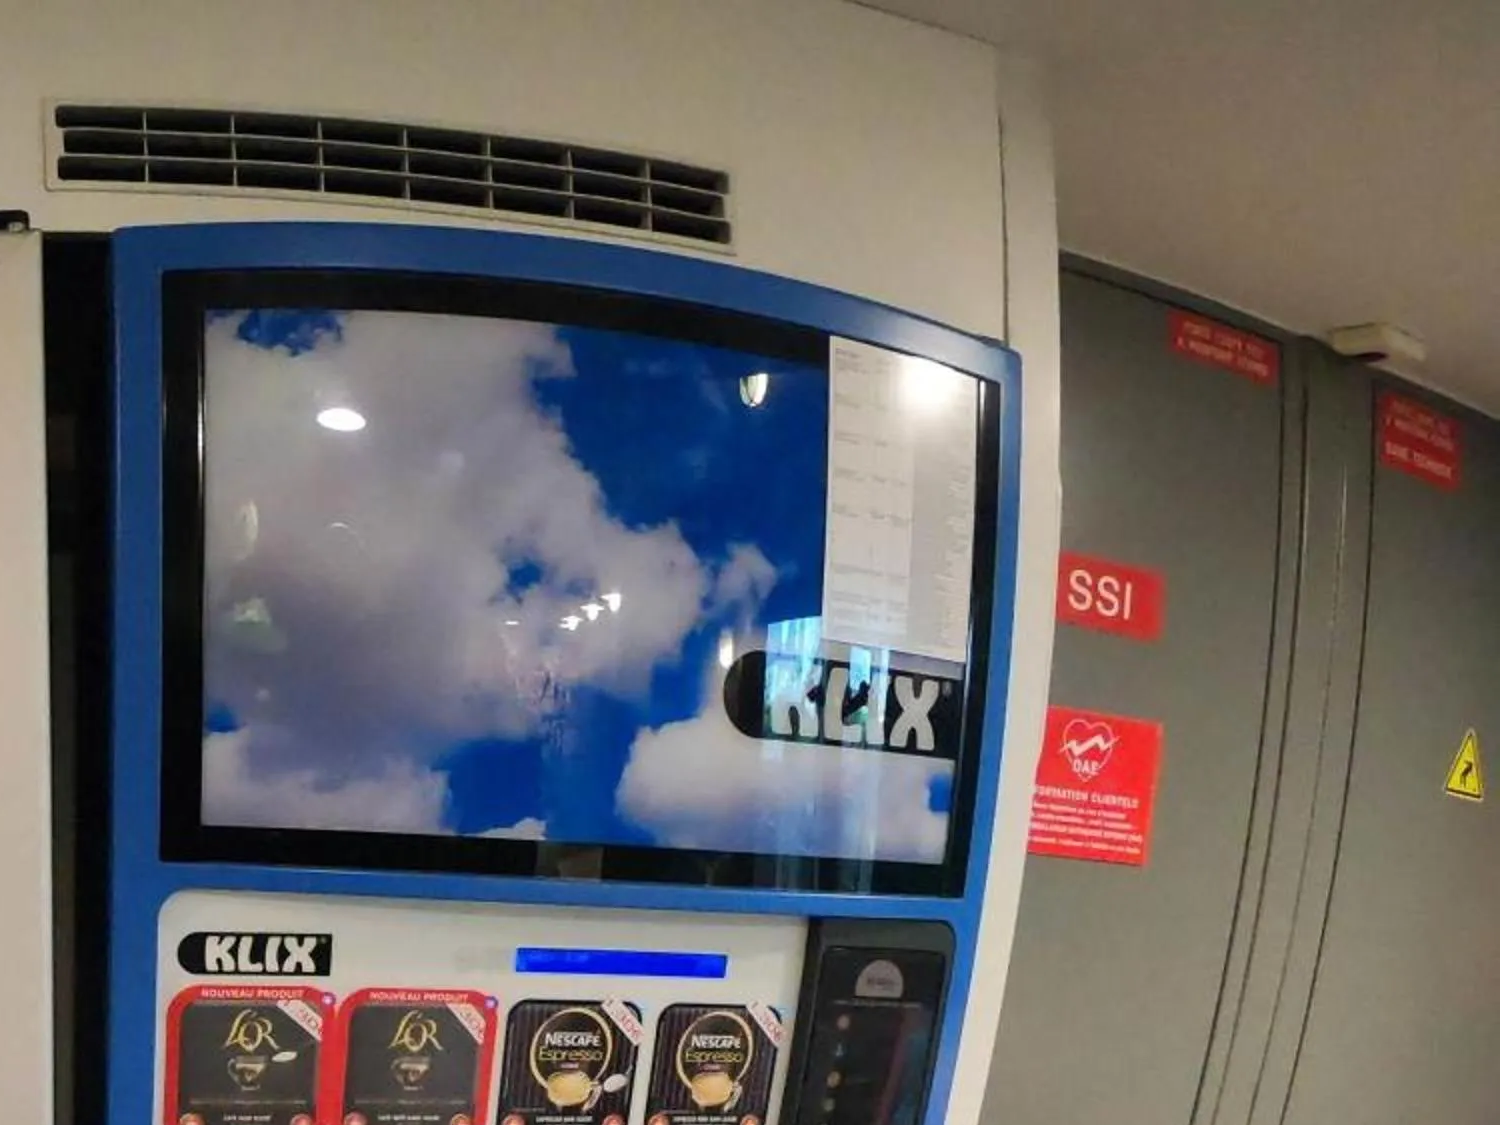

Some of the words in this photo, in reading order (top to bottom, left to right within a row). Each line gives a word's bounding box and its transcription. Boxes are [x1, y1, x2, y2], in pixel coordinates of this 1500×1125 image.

[1068, 569, 1132, 621] SSI
[768, 662, 940, 751] KLIX
[204, 935, 317, 973] KLIX
[539, 1048, 603, 1063] Espresso
[684, 1050, 744, 1063] Espresso
